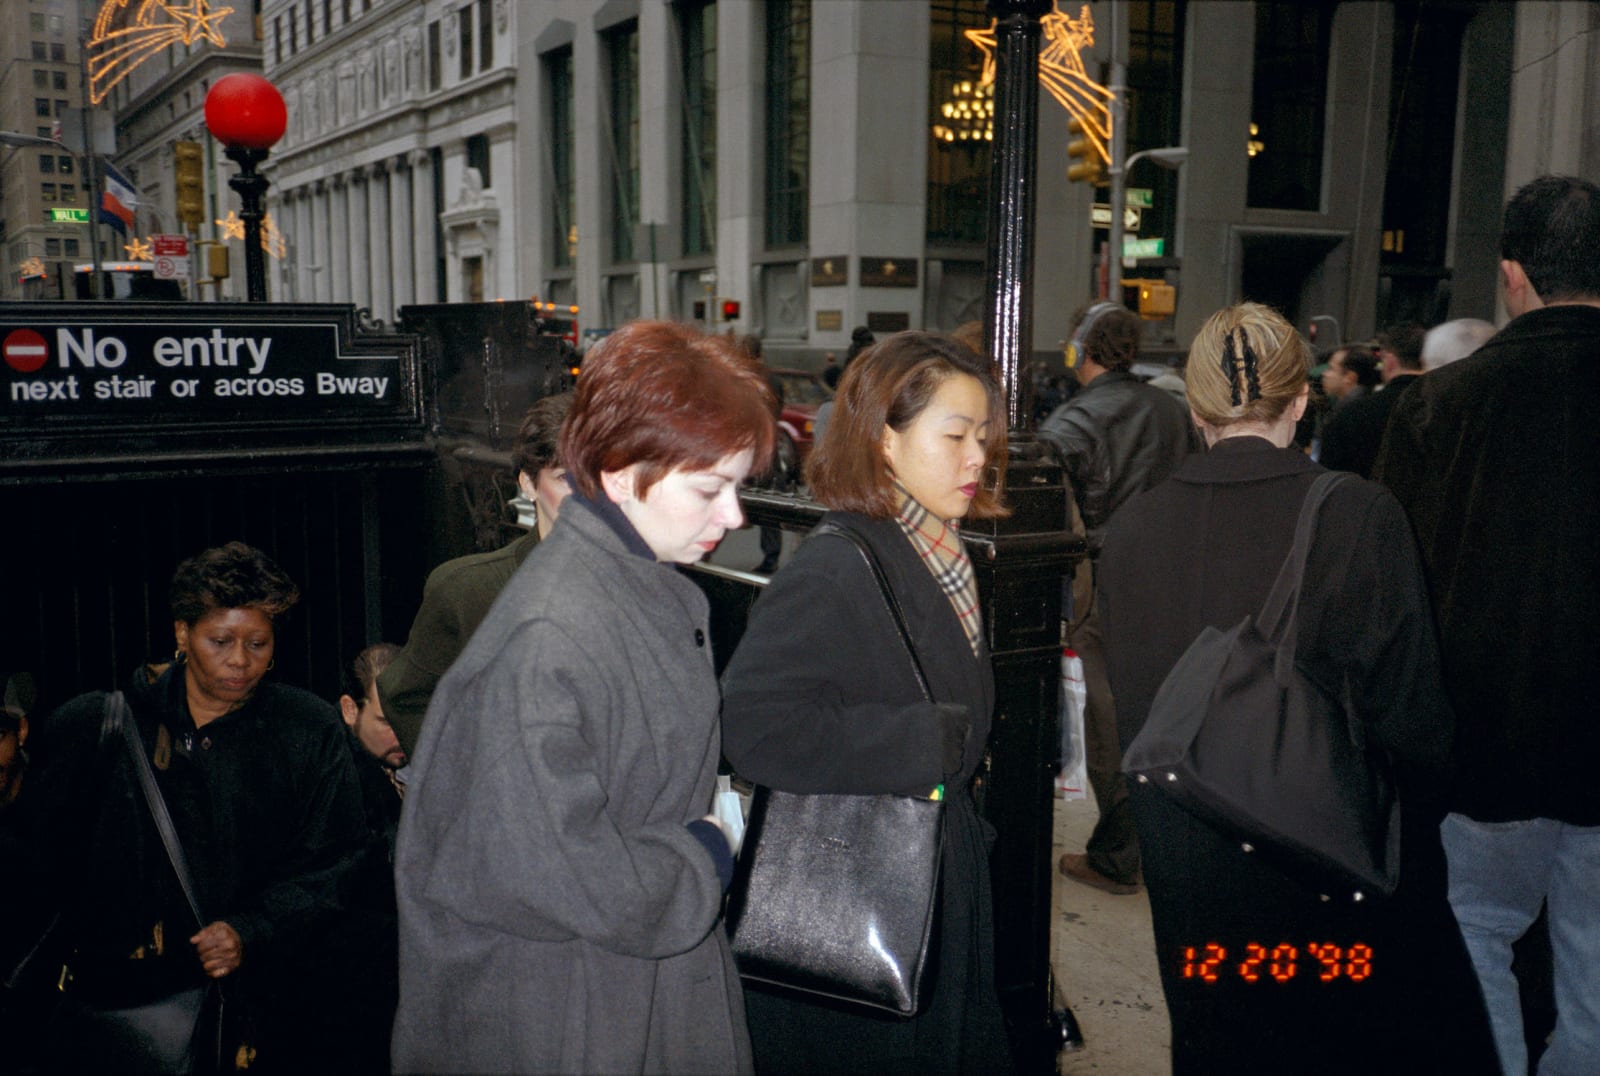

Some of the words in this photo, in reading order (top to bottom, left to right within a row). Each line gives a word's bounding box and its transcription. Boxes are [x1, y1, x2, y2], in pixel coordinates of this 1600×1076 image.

[56, 328, 127, 368] No
[153, 328, 272, 375] entry
[11, 375, 80, 400] next
[94, 375, 155, 399] stair
[170, 379, 199, 397] or
[214, 377, 305, 396] across
[316, 372, 389, 399] Bway
